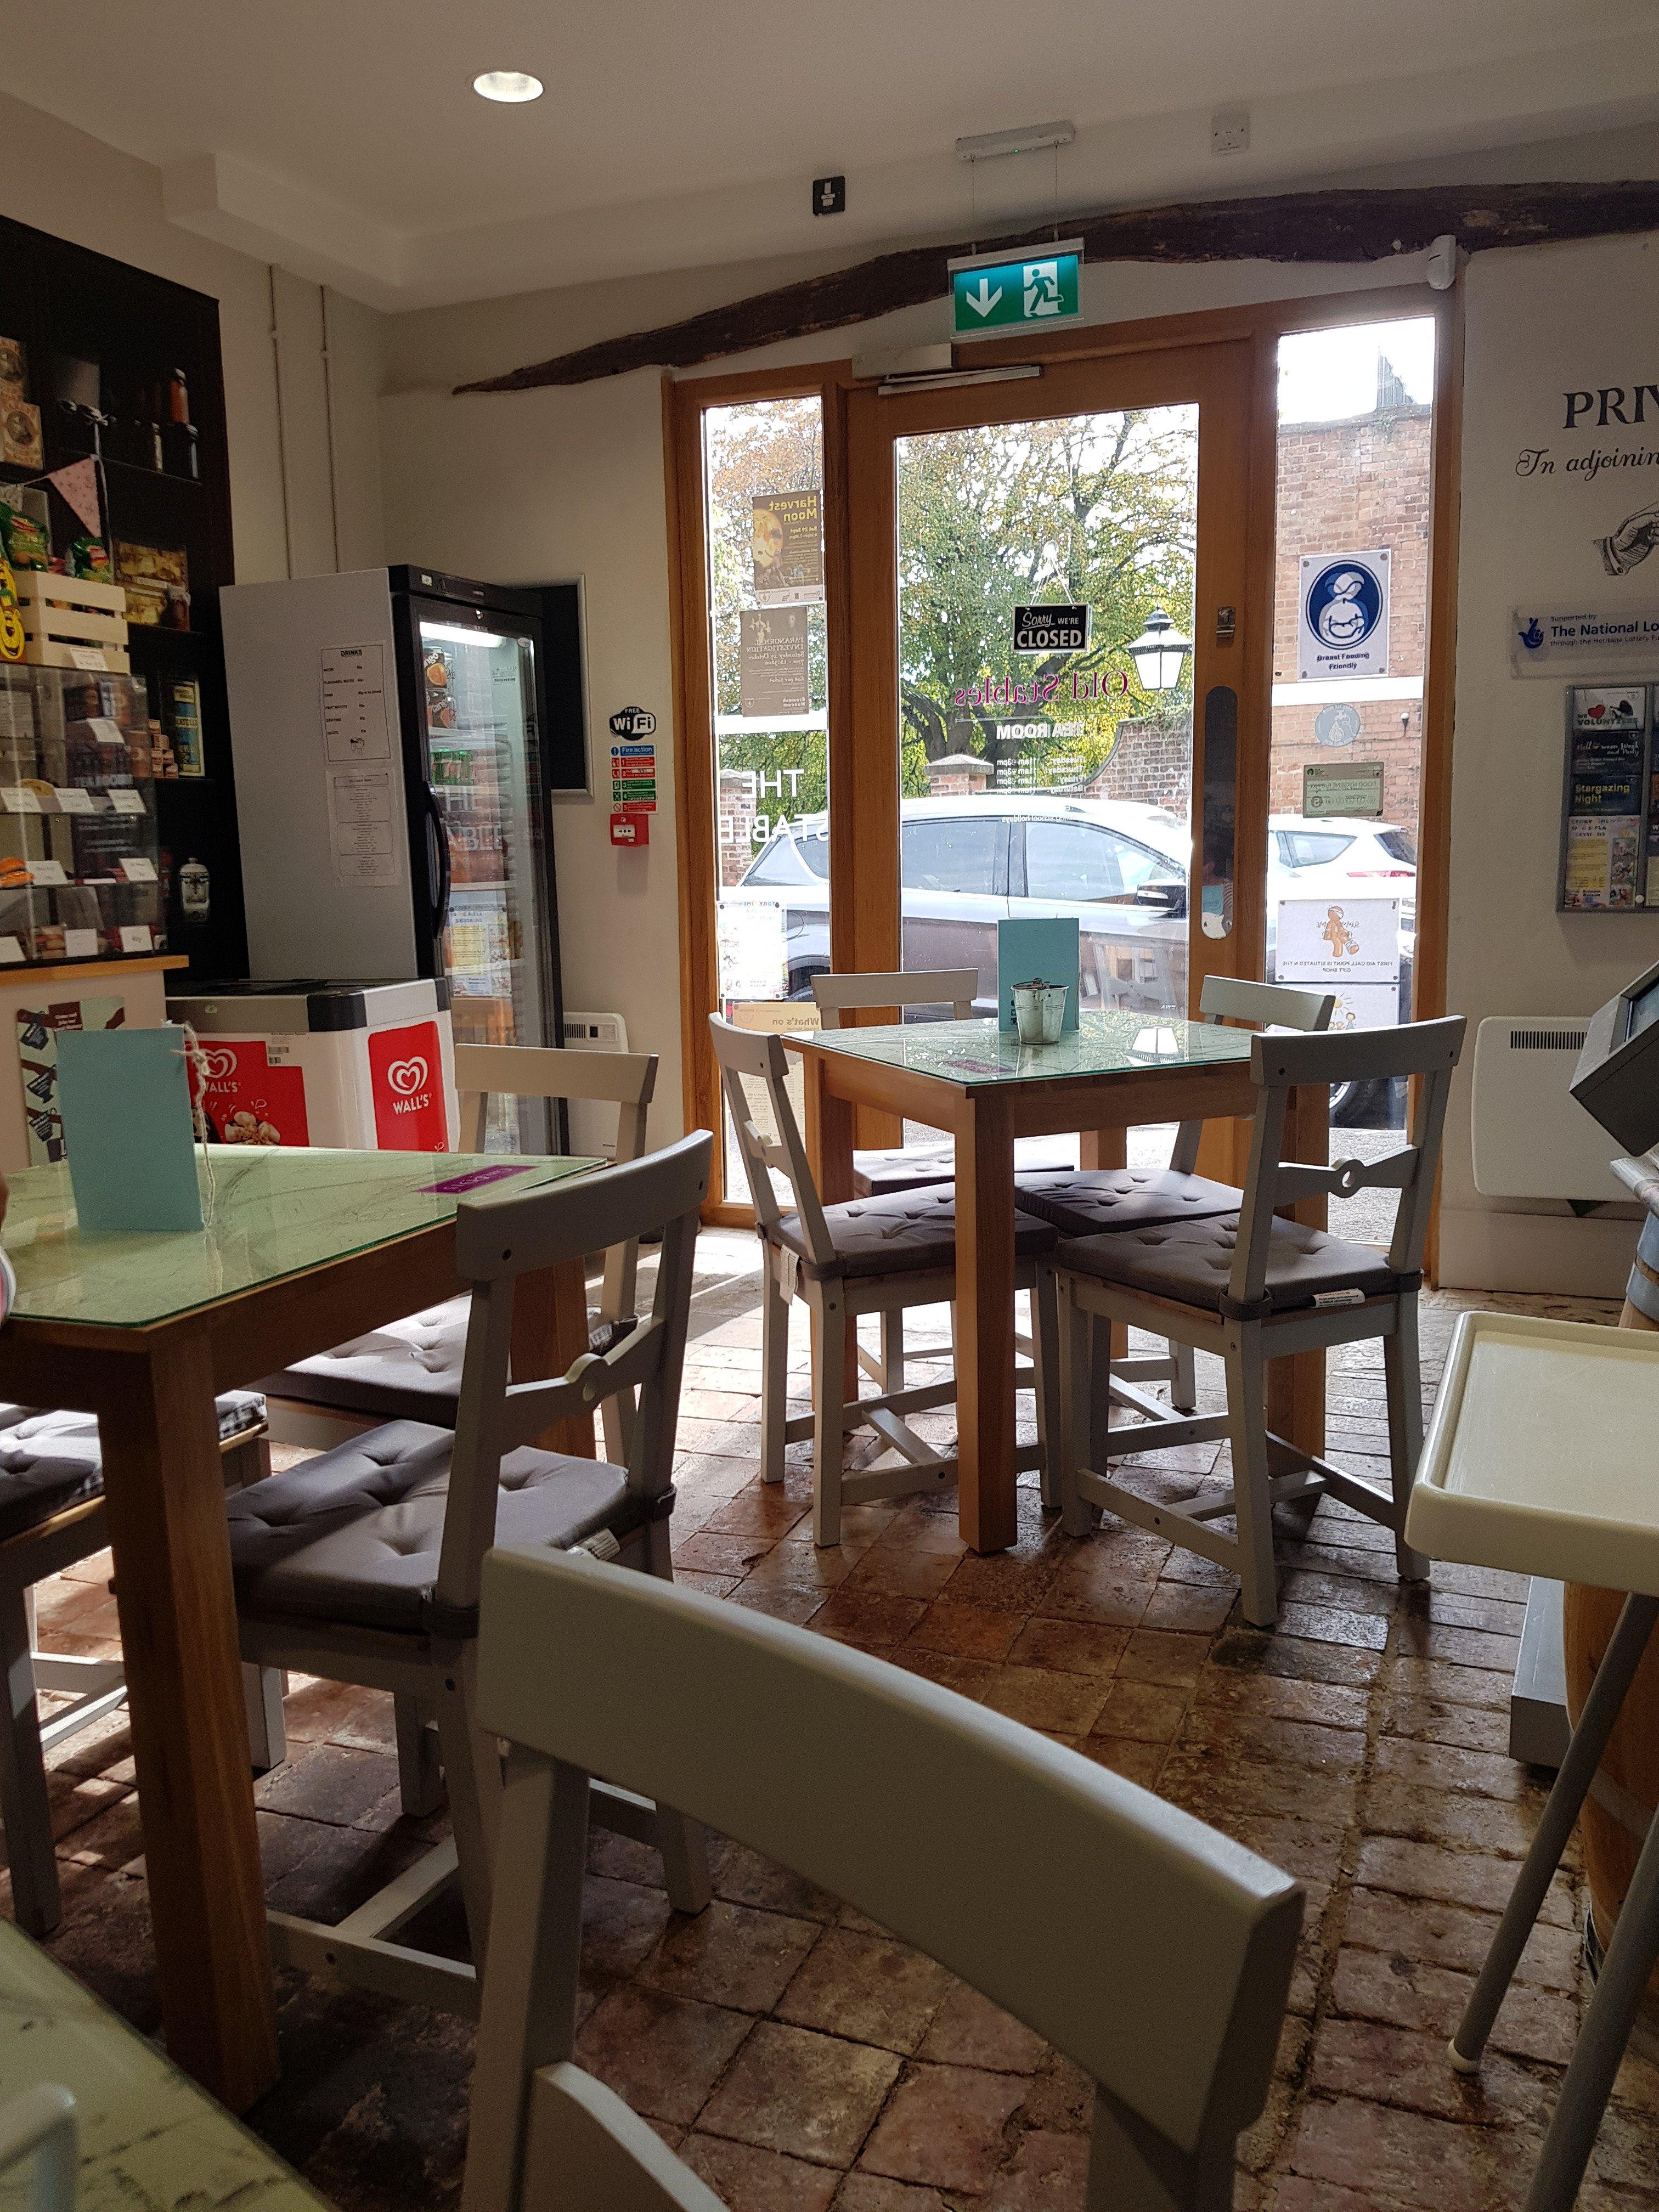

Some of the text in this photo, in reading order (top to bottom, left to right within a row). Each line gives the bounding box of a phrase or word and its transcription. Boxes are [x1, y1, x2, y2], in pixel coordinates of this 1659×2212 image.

[1516, 449, 1556, 476] In
[1022, 612, 1055, 629] Sorry
[1550, 613, 1597, 623] Supported by
[1551, 625, 1576, 637] The
[1581, 620, 1639, 636] National
[1017, 628, 1082, 648] CLOSED
[341, 649, 362, 657] DRINKS
[1329, 662, 1357, 670] Friendly
[1575, 783, 1631, 794] Stargazing
[1575, 794, 1602, 804] Night
[392, 1094, 429, 1115] WALL'S
